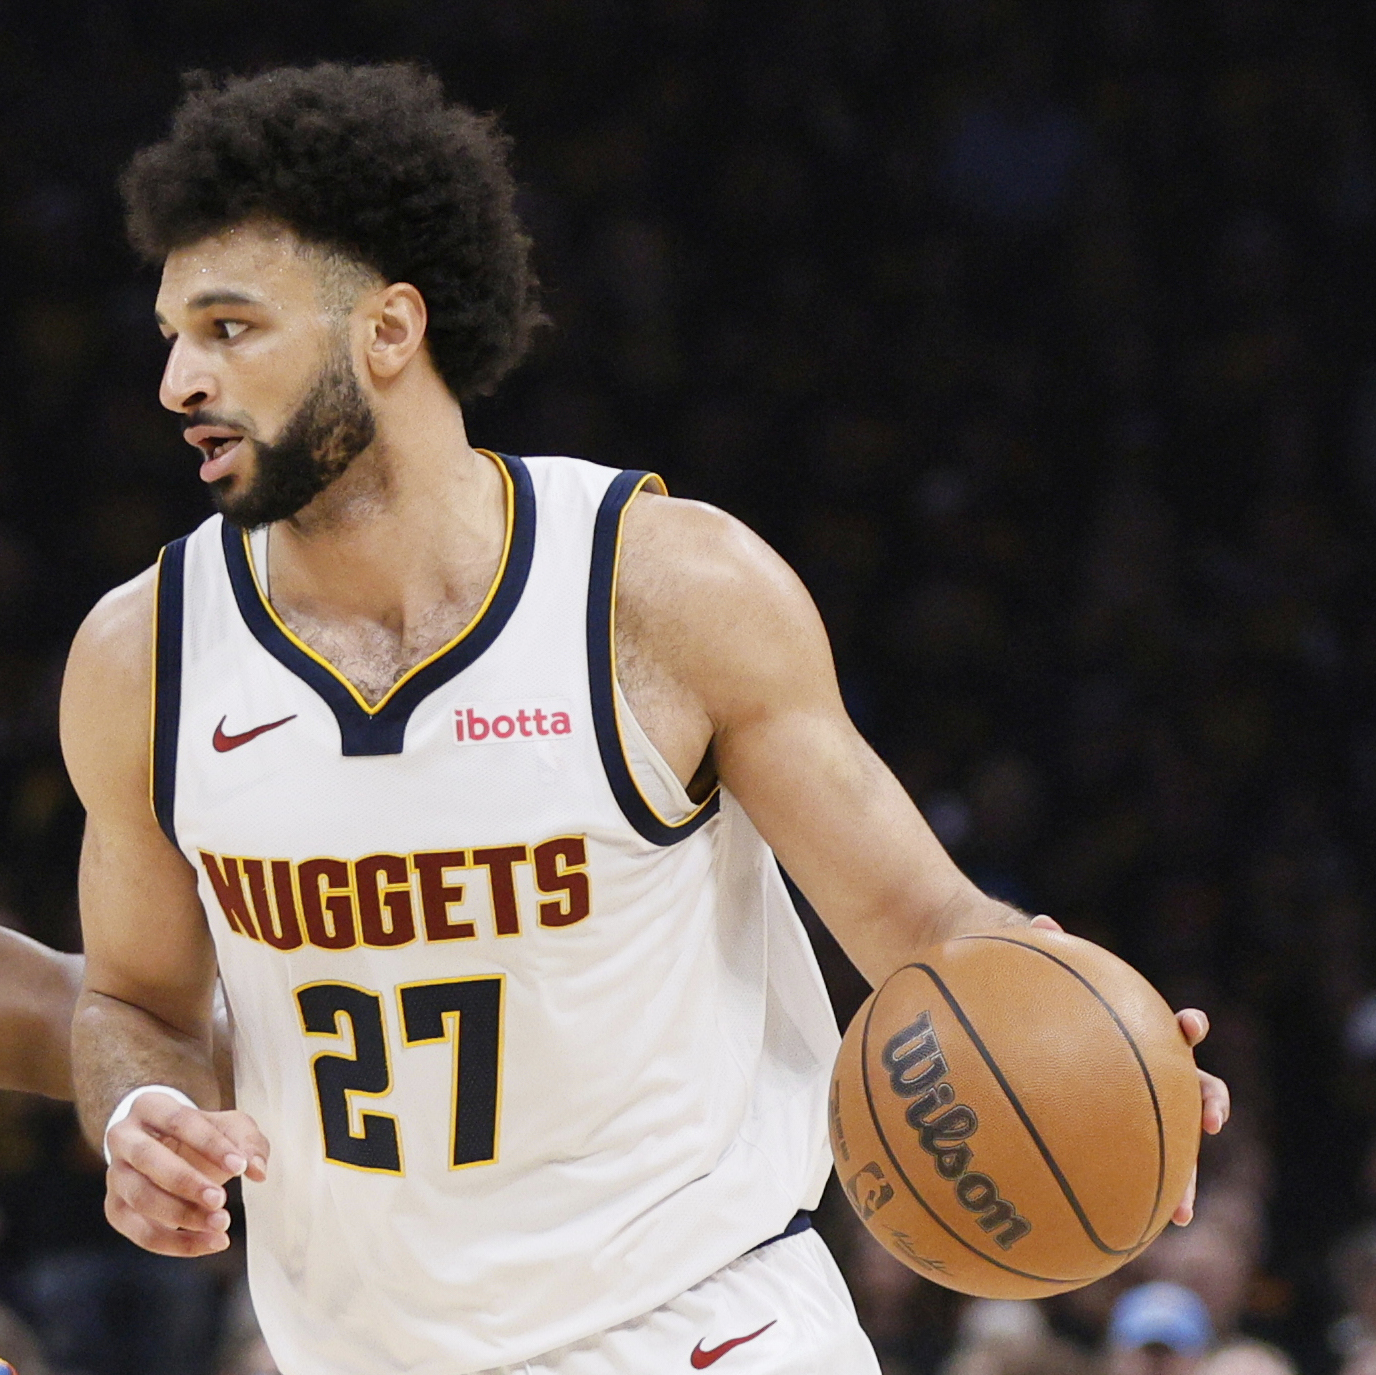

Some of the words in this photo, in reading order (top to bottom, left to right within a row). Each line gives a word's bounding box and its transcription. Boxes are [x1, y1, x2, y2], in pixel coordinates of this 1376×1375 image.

[454, 708, 572, 742] ibotta
[197, 834, 592, 954] NUGGETS
[293, 973, 506, 1177] 27
[881, 1010, 1033, 1252] Wilson
